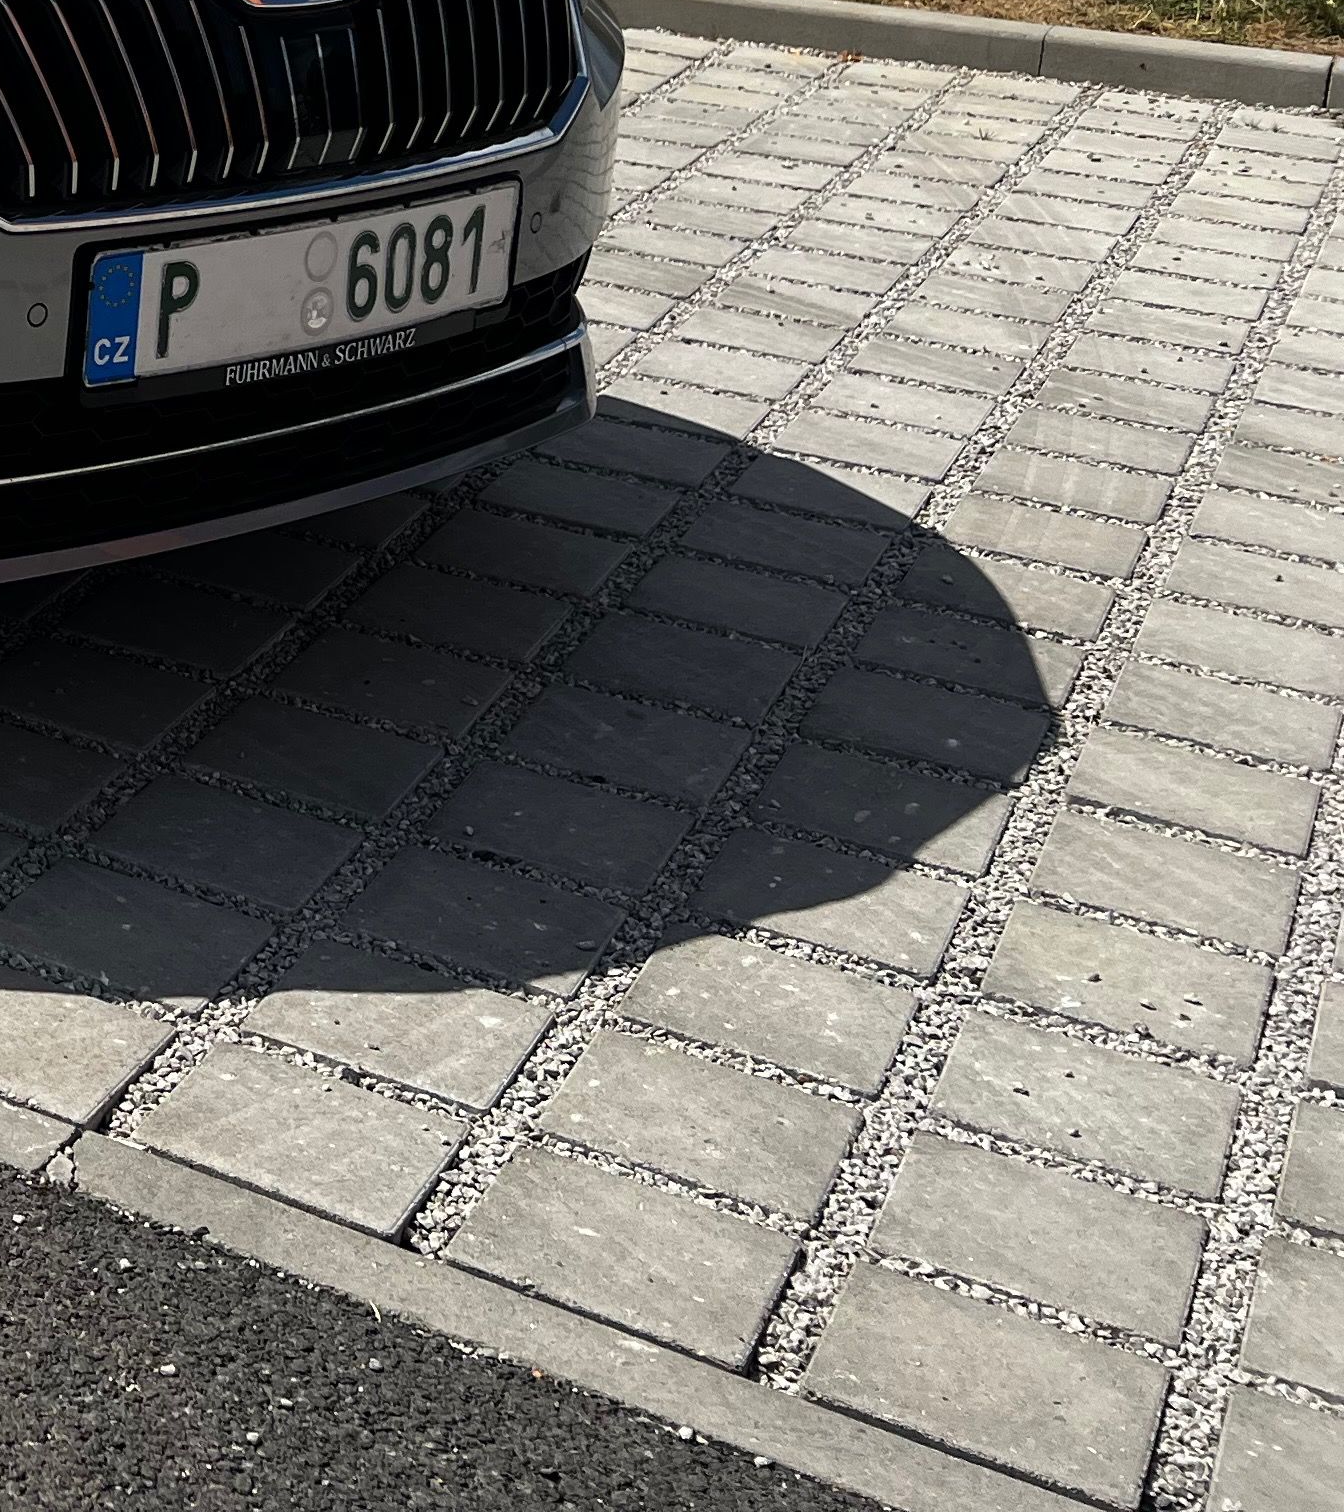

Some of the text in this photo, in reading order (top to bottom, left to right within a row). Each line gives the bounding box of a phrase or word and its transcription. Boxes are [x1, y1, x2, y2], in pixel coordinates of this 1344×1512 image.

[156, 204, 487, 359] P 6081
[93, 335, 131, 366] CZ
[225, 327, 417, 386] FUHRMANN & SCHWARZ
